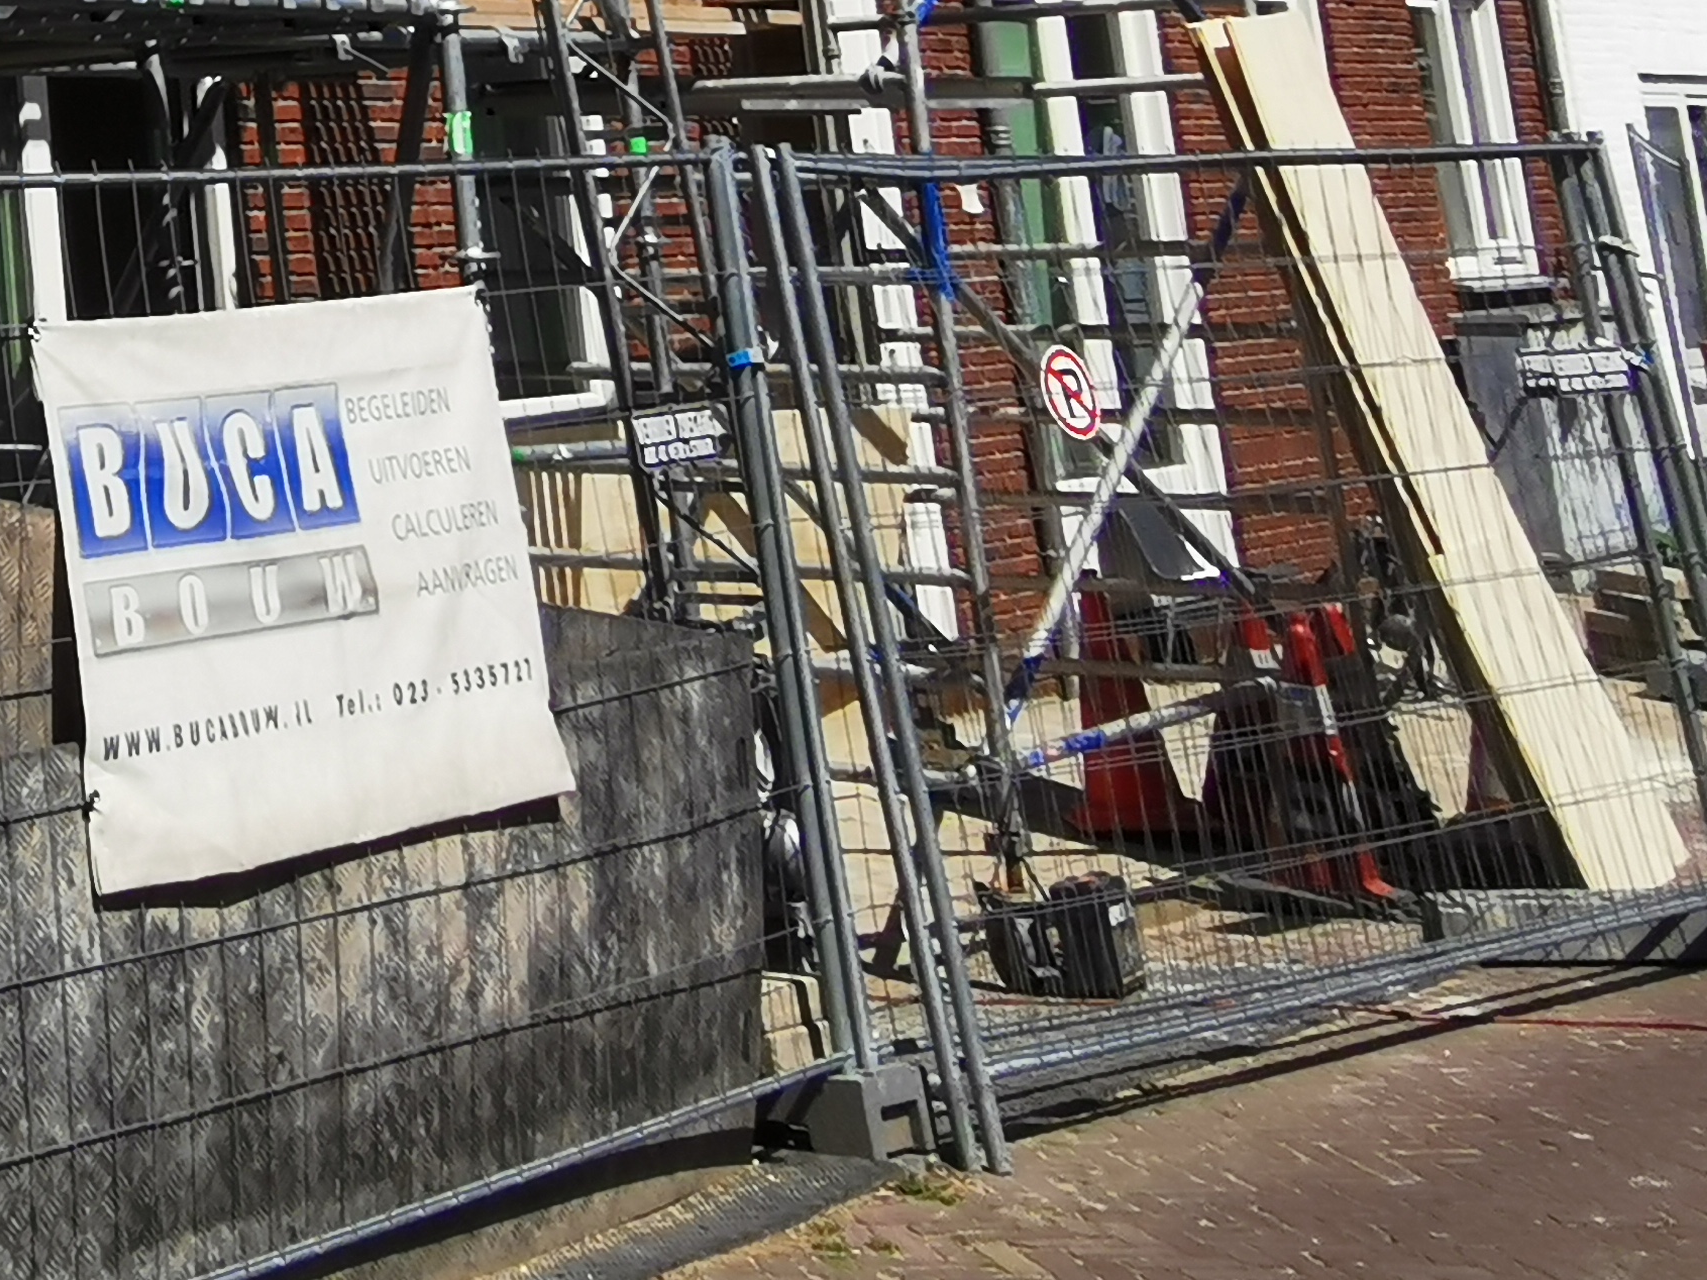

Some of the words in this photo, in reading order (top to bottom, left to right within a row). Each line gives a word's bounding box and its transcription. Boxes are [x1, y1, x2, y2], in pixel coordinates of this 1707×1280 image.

[345, 387, 451, 425] BEGELEIDEN
[76, 403, 344, 538] BUCA
[367, 445, 471, 485] UITVOEREN
[391, 500, 499, 541] CALCULEREN
[416, 554, 520, 598] AANVRAGEN
[109, 552, 365, 647] BOUW
